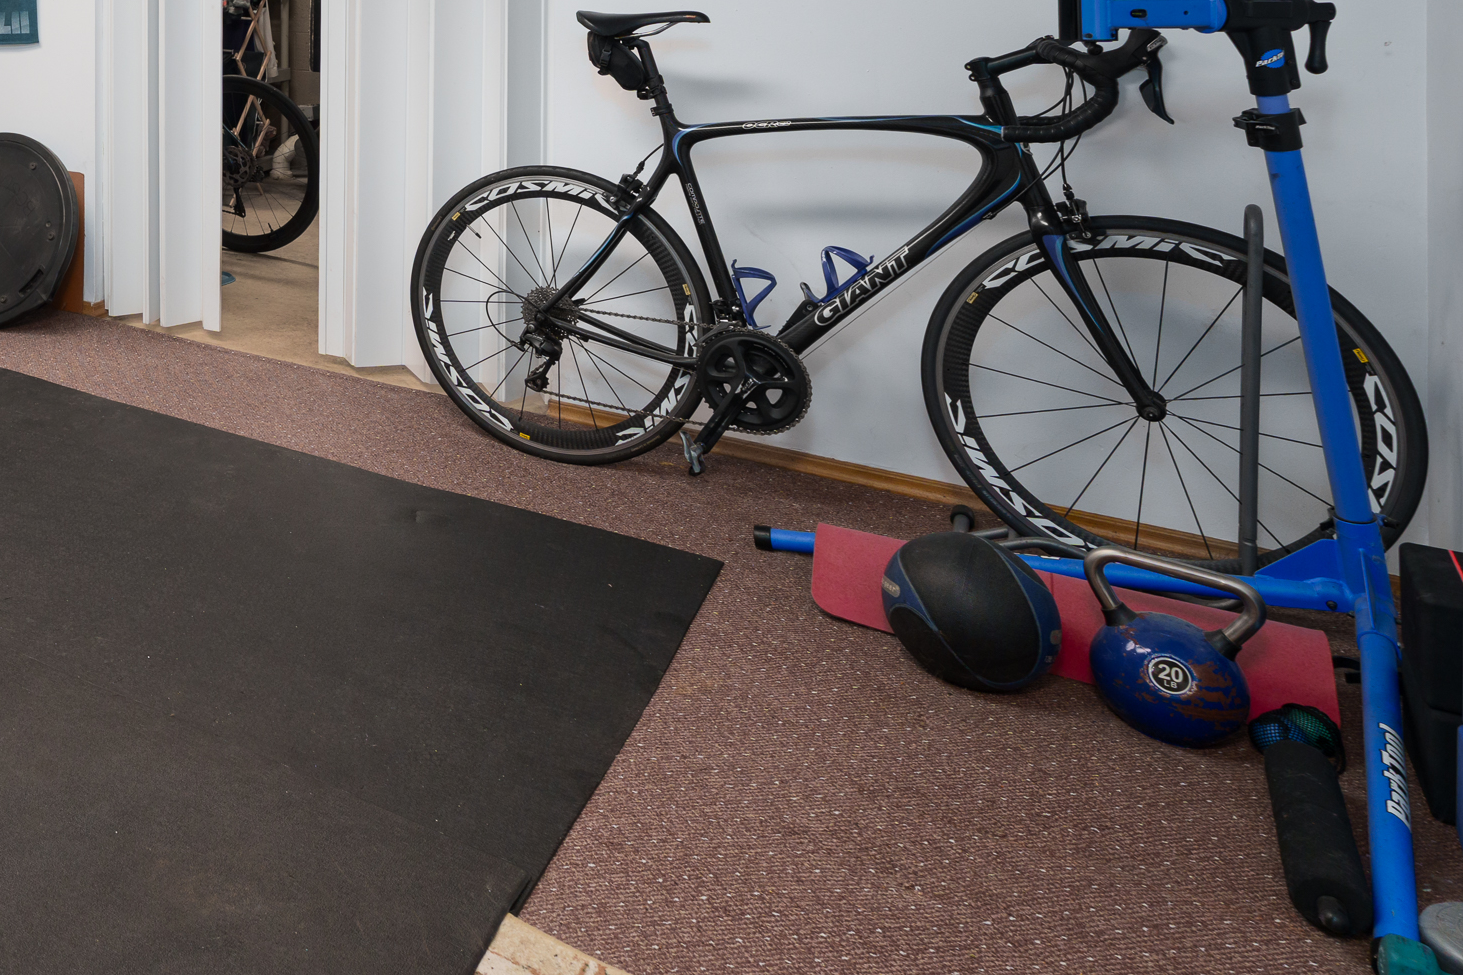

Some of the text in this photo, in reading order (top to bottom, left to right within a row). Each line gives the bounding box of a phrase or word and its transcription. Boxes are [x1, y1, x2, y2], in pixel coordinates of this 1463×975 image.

[815, 245, 909, 325] GIANT
[1158, 664, 1183, 683] 20
[1164, 680, 1178, 689] LB
